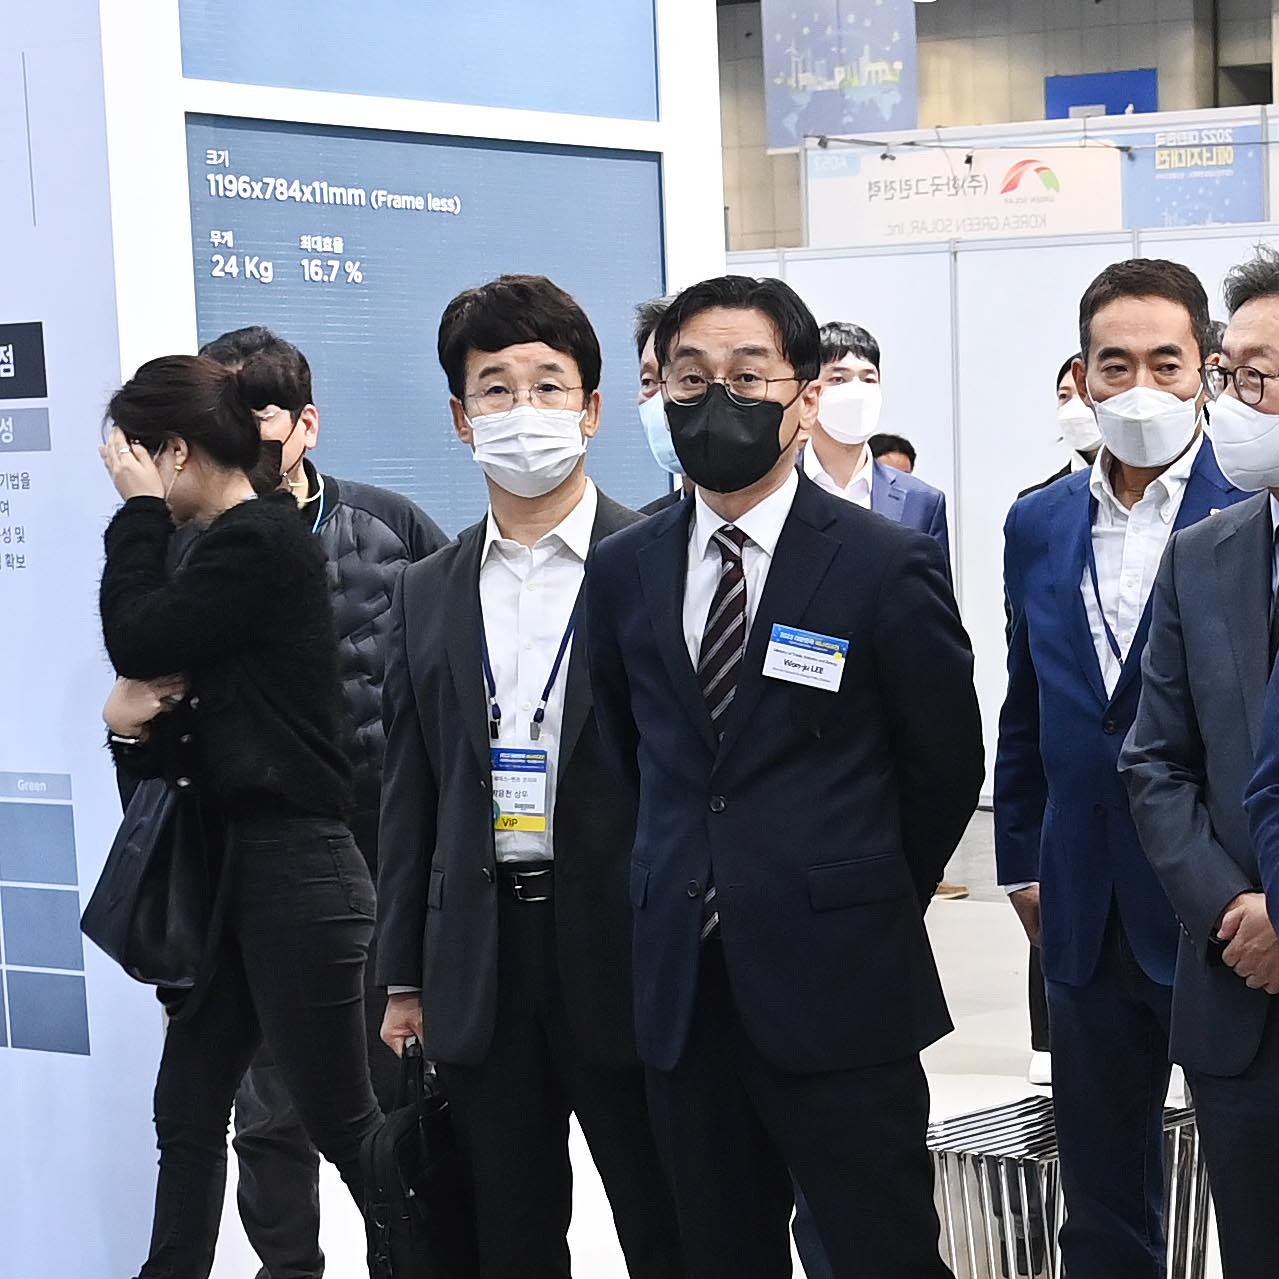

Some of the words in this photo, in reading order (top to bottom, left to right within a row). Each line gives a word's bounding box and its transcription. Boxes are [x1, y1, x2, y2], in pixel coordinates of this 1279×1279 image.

[206, 150, 230, 168] 크기
[207, 173, 367, 206] 1196x784x11mm
[370, 189, 424, 210] (Frame
[426, 192, 461, 215] less)
[210, 231, 234, 248] 무게
[211, 255, 239, 278] 24
[244, 256, 274, 283] Kg
[301, 259, 340, 282] 16.7
[344, 260, 363, 284] %
[0, 526, 12, 544] 성
[17, 779, 47, 793] Green
[502, 818, 518, 827] VIP
